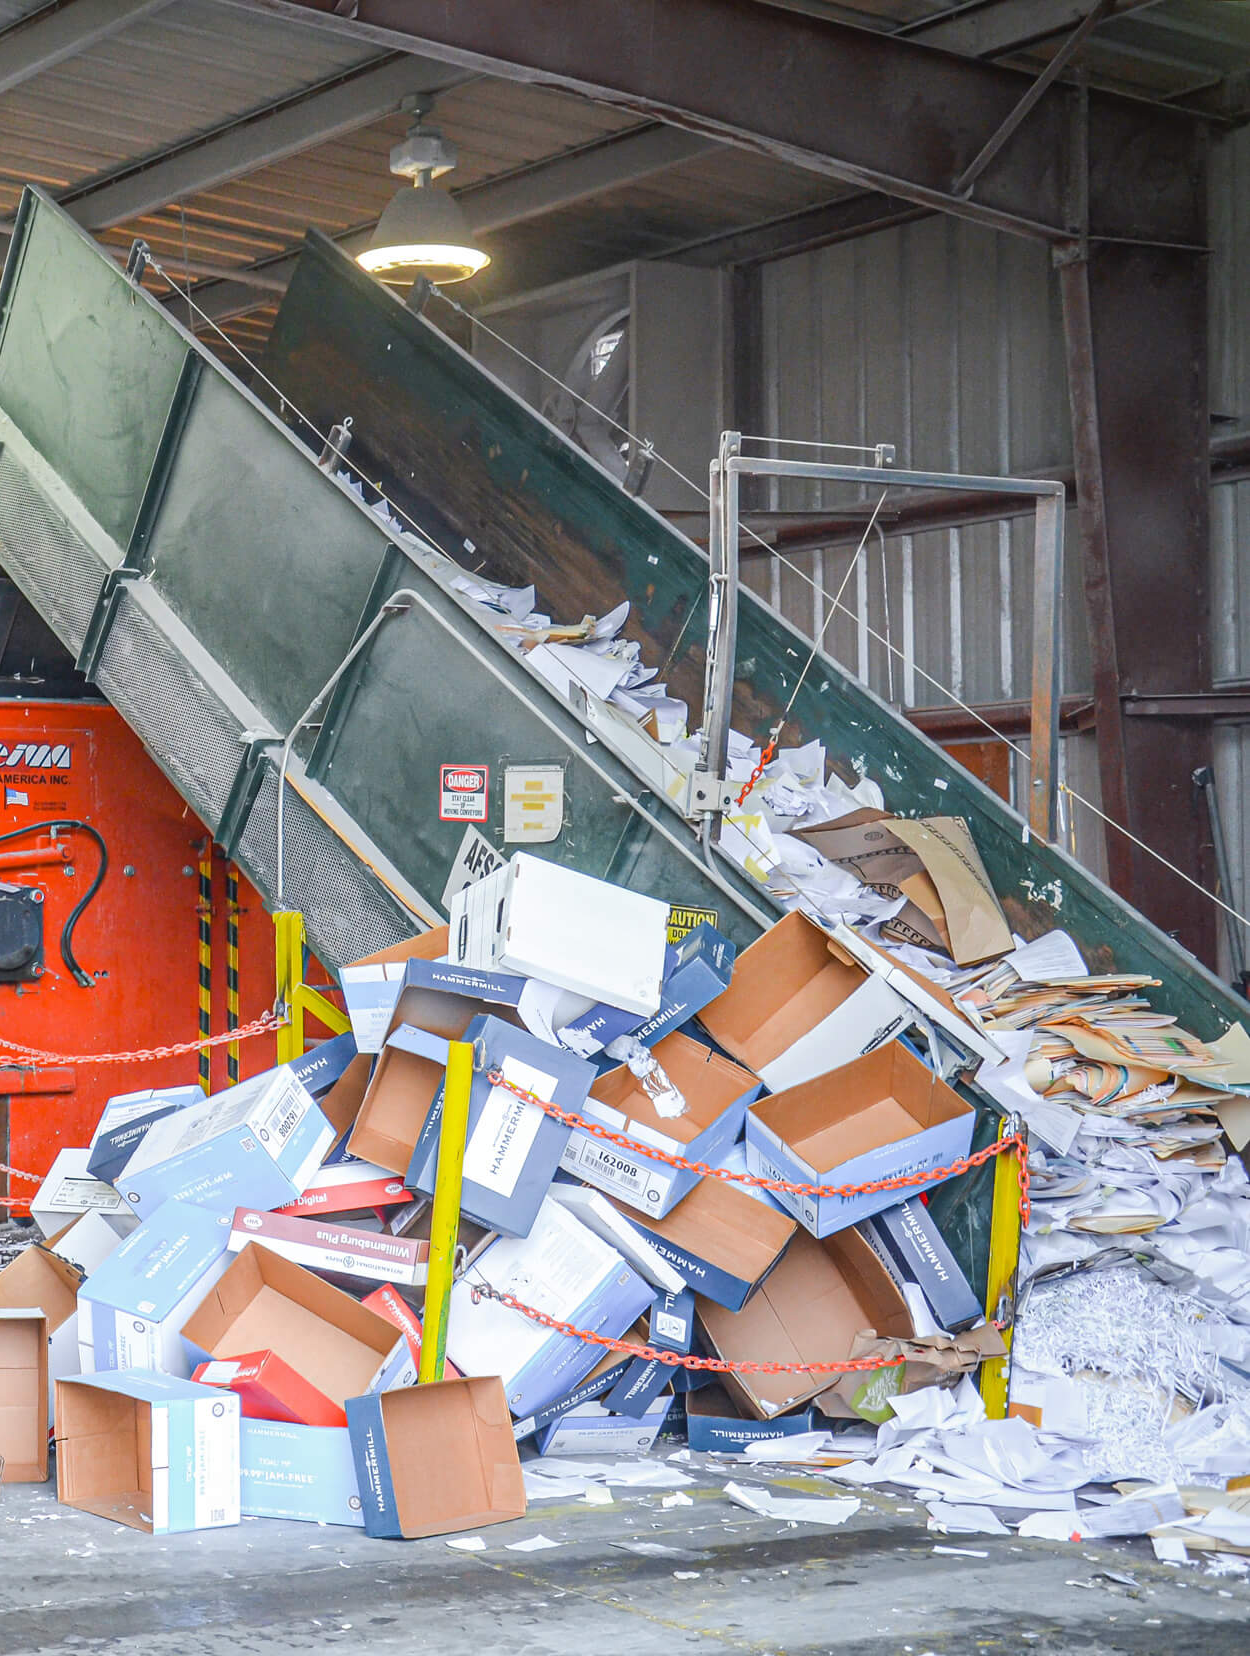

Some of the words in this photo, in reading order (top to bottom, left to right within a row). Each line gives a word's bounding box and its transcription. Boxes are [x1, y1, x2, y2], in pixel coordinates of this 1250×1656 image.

[50, 774, 71, 785] INC.
[448, 774, 480, 788] DANGER
[668, 909, 715, 928] AUTION
[432, 973, 508, 993] HAMMERMILL
[489, 1088, 531, 1175] HAMMERMI
[598, 1151, 638, 1177] 162008
[297, 1193, 328, 1207] Digital
[316, 1231, 339, 1244] Plus
[340, 1233, 410, 1258] Williamsburg
[901, 1201, 949, 1281] HAMMERMIL
[356, 1261, 404, 1275] INTERNATIONAL
[540, 1368, 625, 1418] HAMMERMILL
[710, 1429, 784, 1439] HAMMERMILL
[365, 1427, 386, 1512] HAMMERMILL
